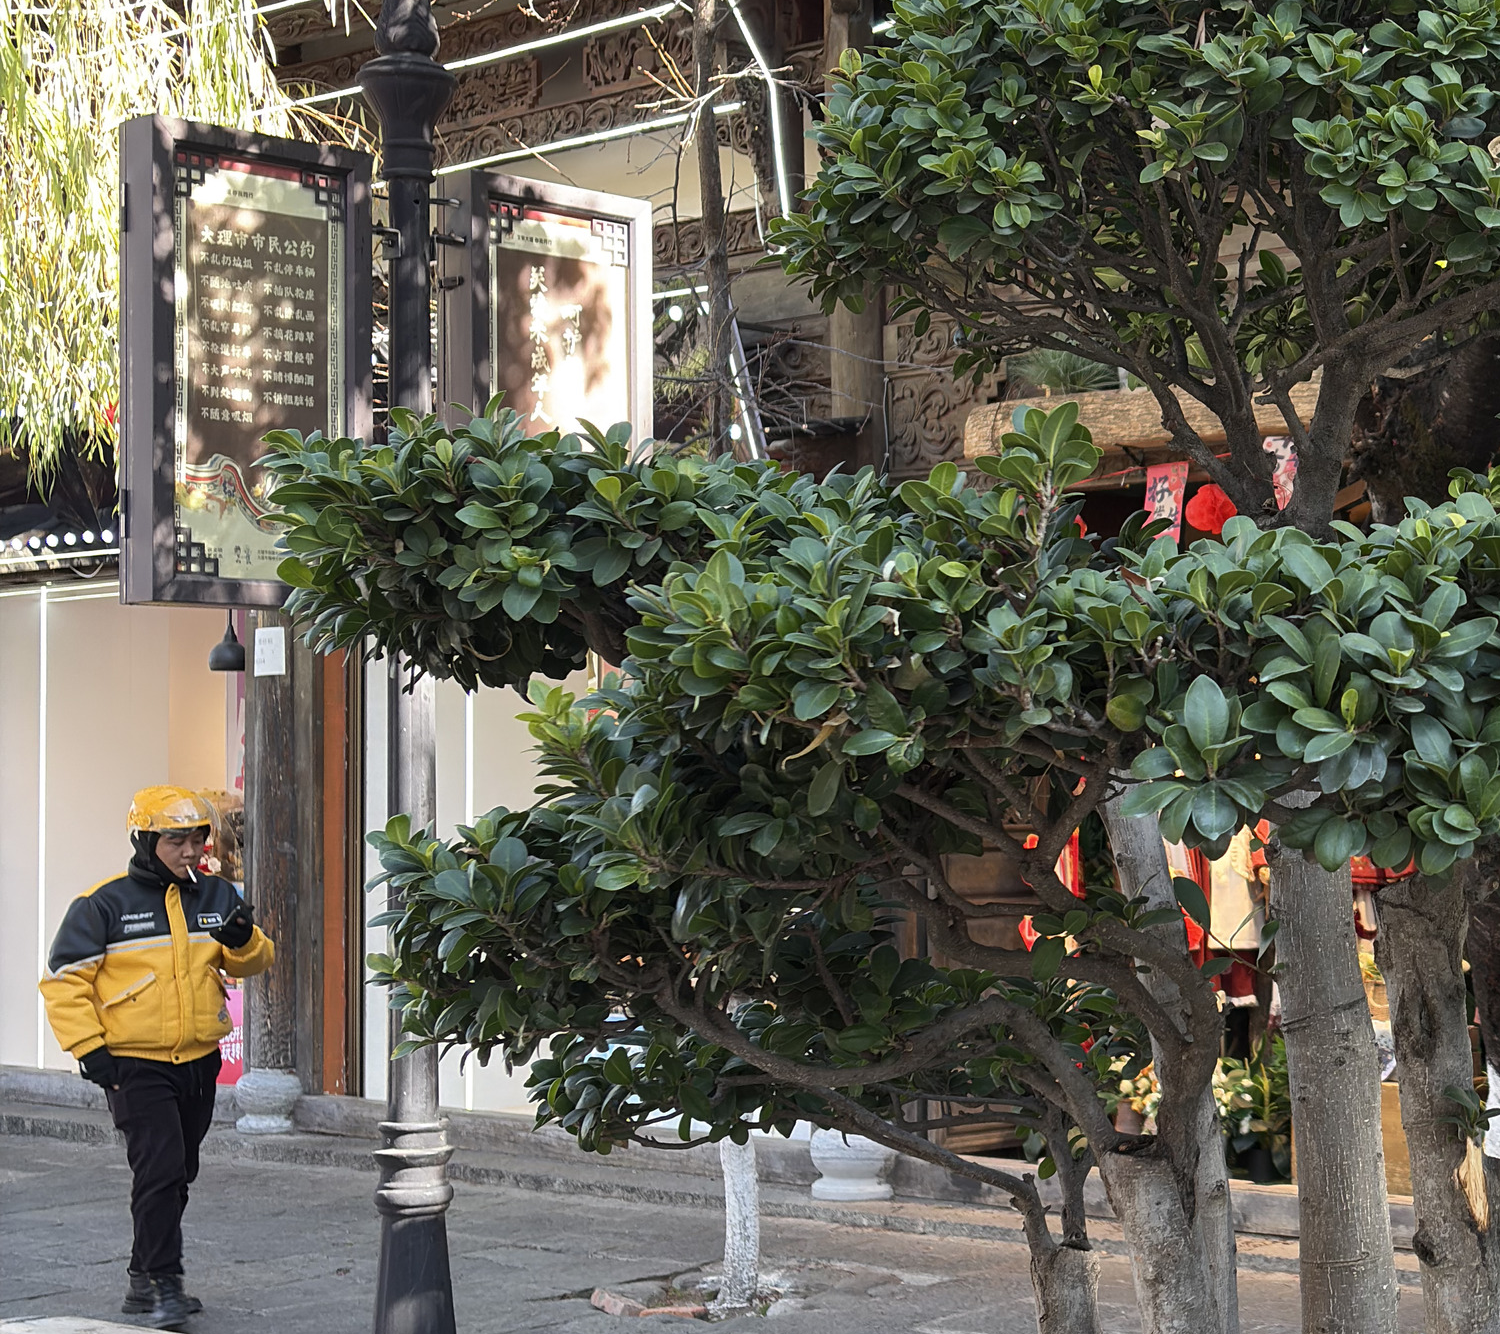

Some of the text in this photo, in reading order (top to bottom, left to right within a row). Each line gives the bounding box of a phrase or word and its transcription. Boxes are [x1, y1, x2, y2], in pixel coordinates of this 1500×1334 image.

[200, 224, 316, 259] 大理市市民公约
[200, 251, 253, 270] 不乱扔垃圾
